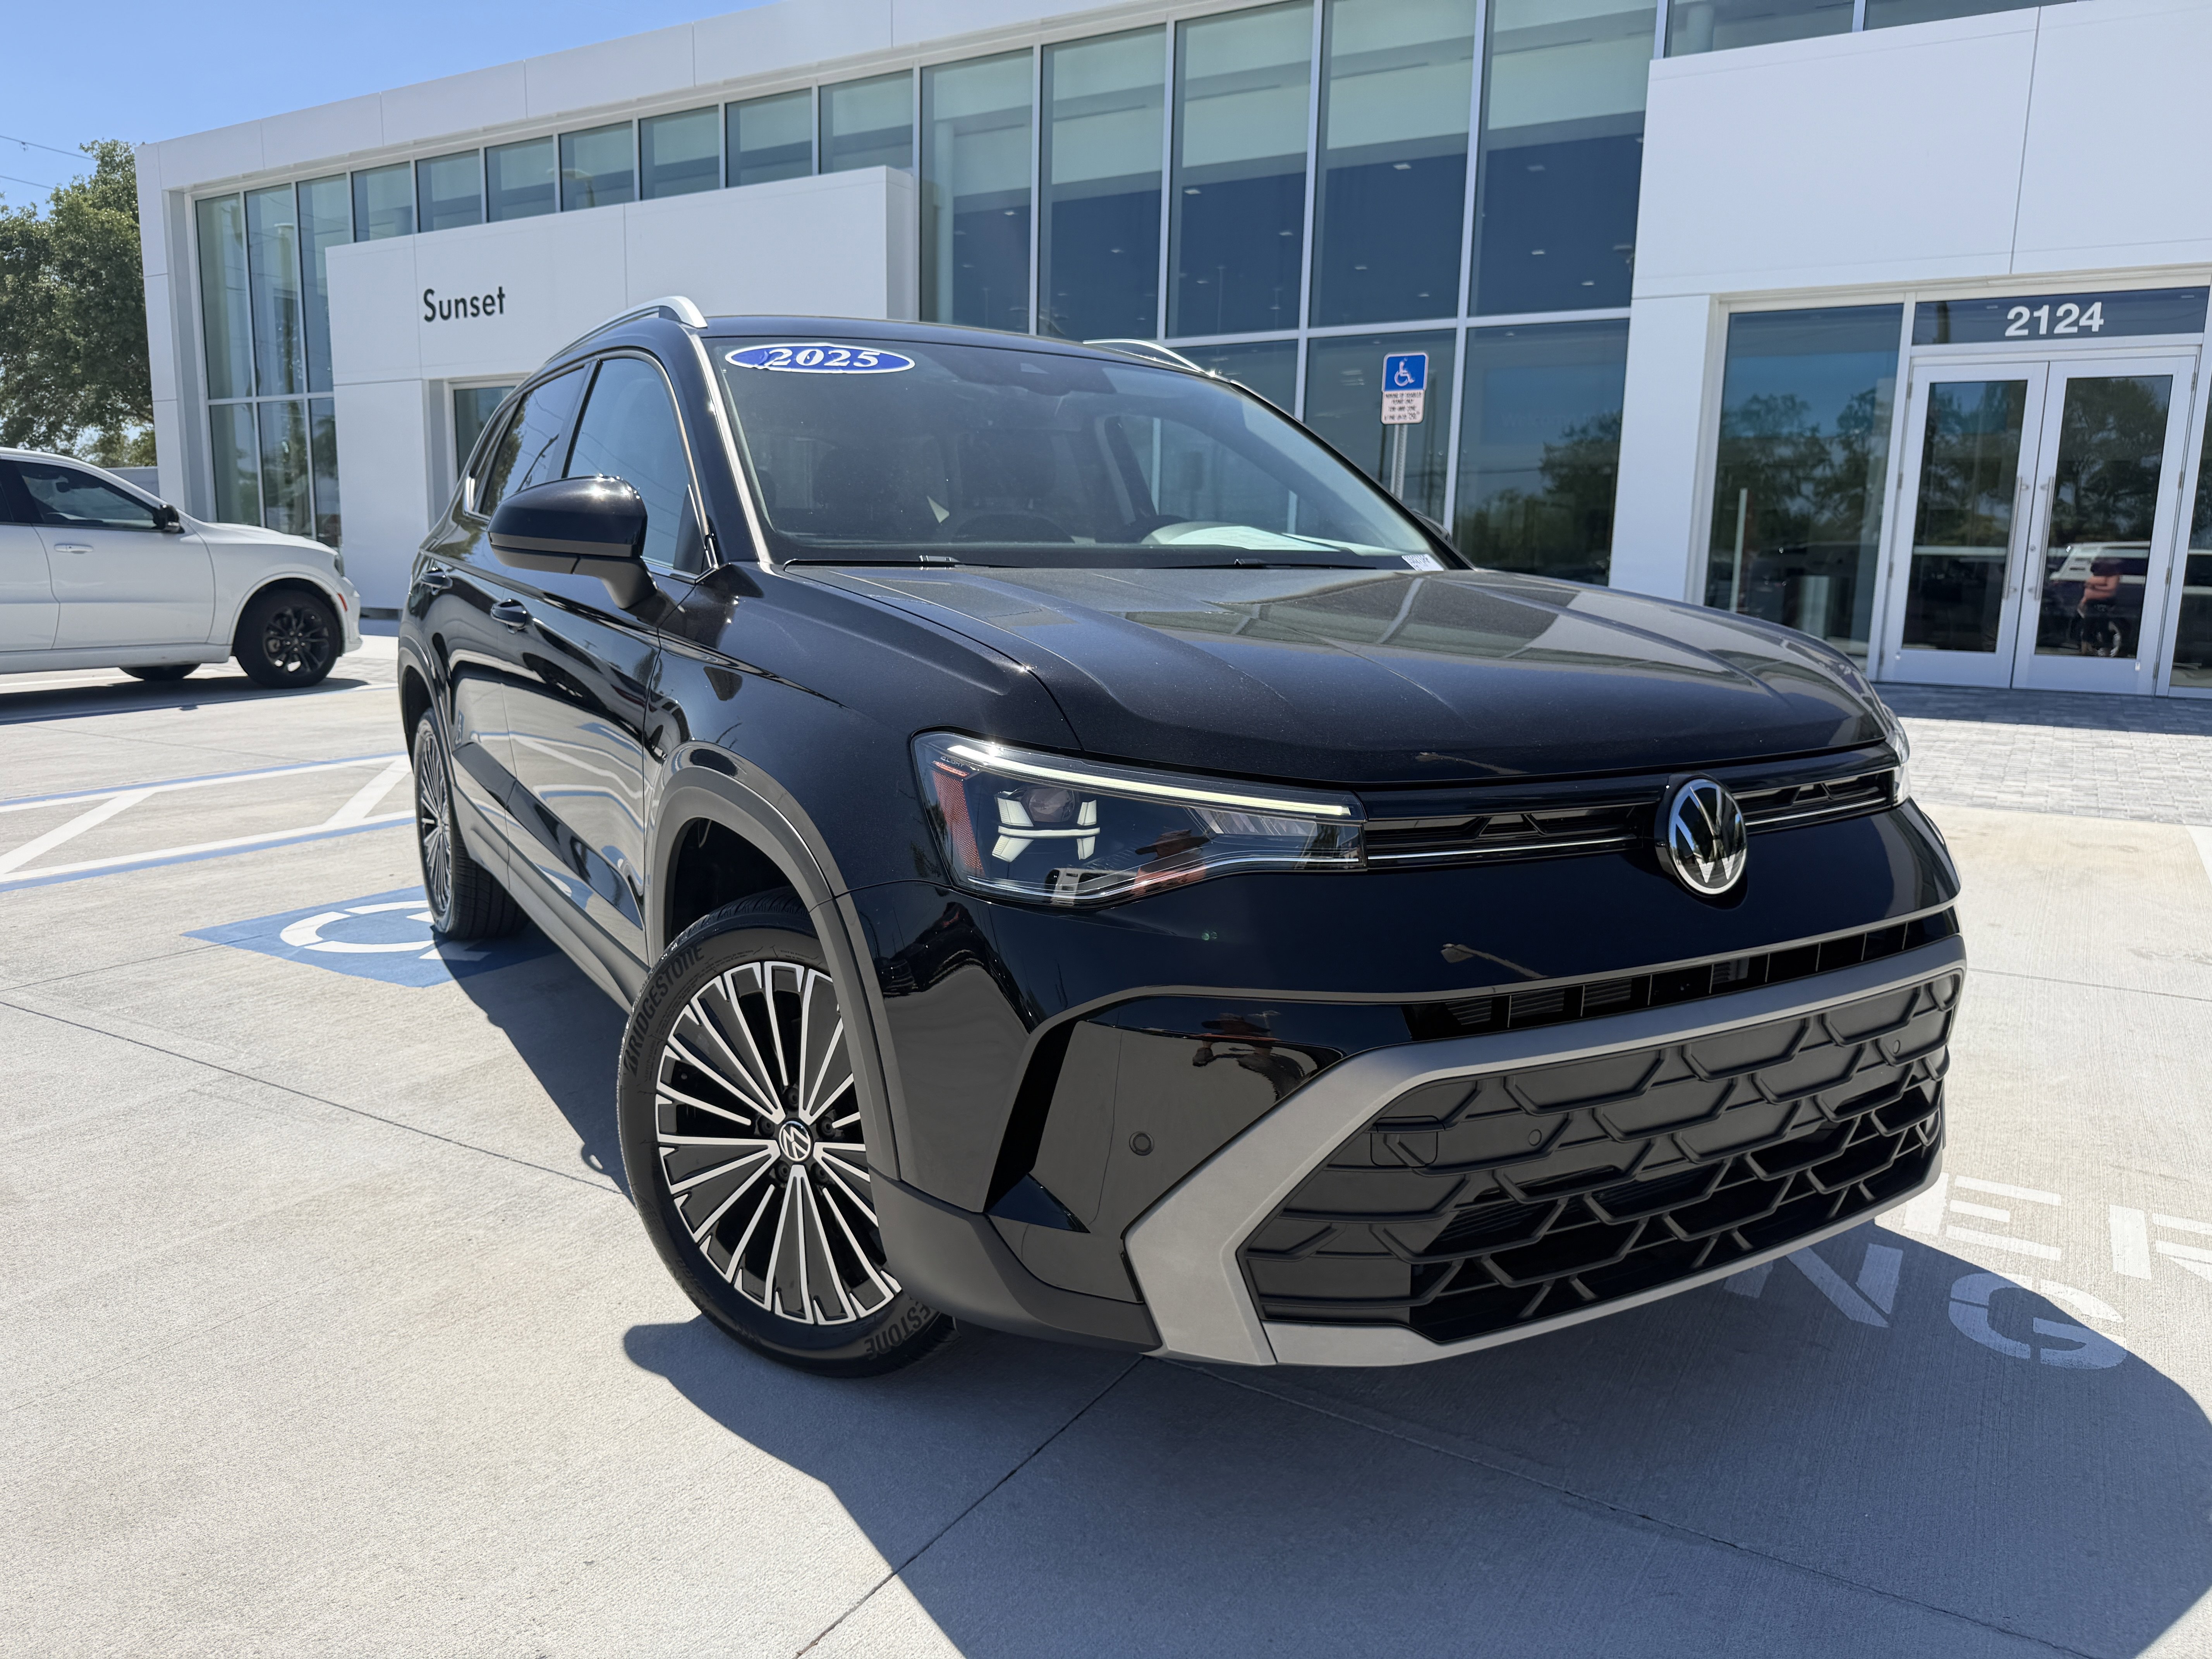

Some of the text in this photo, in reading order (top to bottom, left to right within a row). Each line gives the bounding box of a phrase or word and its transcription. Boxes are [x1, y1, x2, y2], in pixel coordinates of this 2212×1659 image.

[424, 286, 505, 322] Sunset
[2005, 301, 2104, 337] 2124
[765, 348, 880, 368] 2025
[623, 947, 705, 1077] BRIDGESTONE
[864, 1301, 931, 1360] ESTONE
